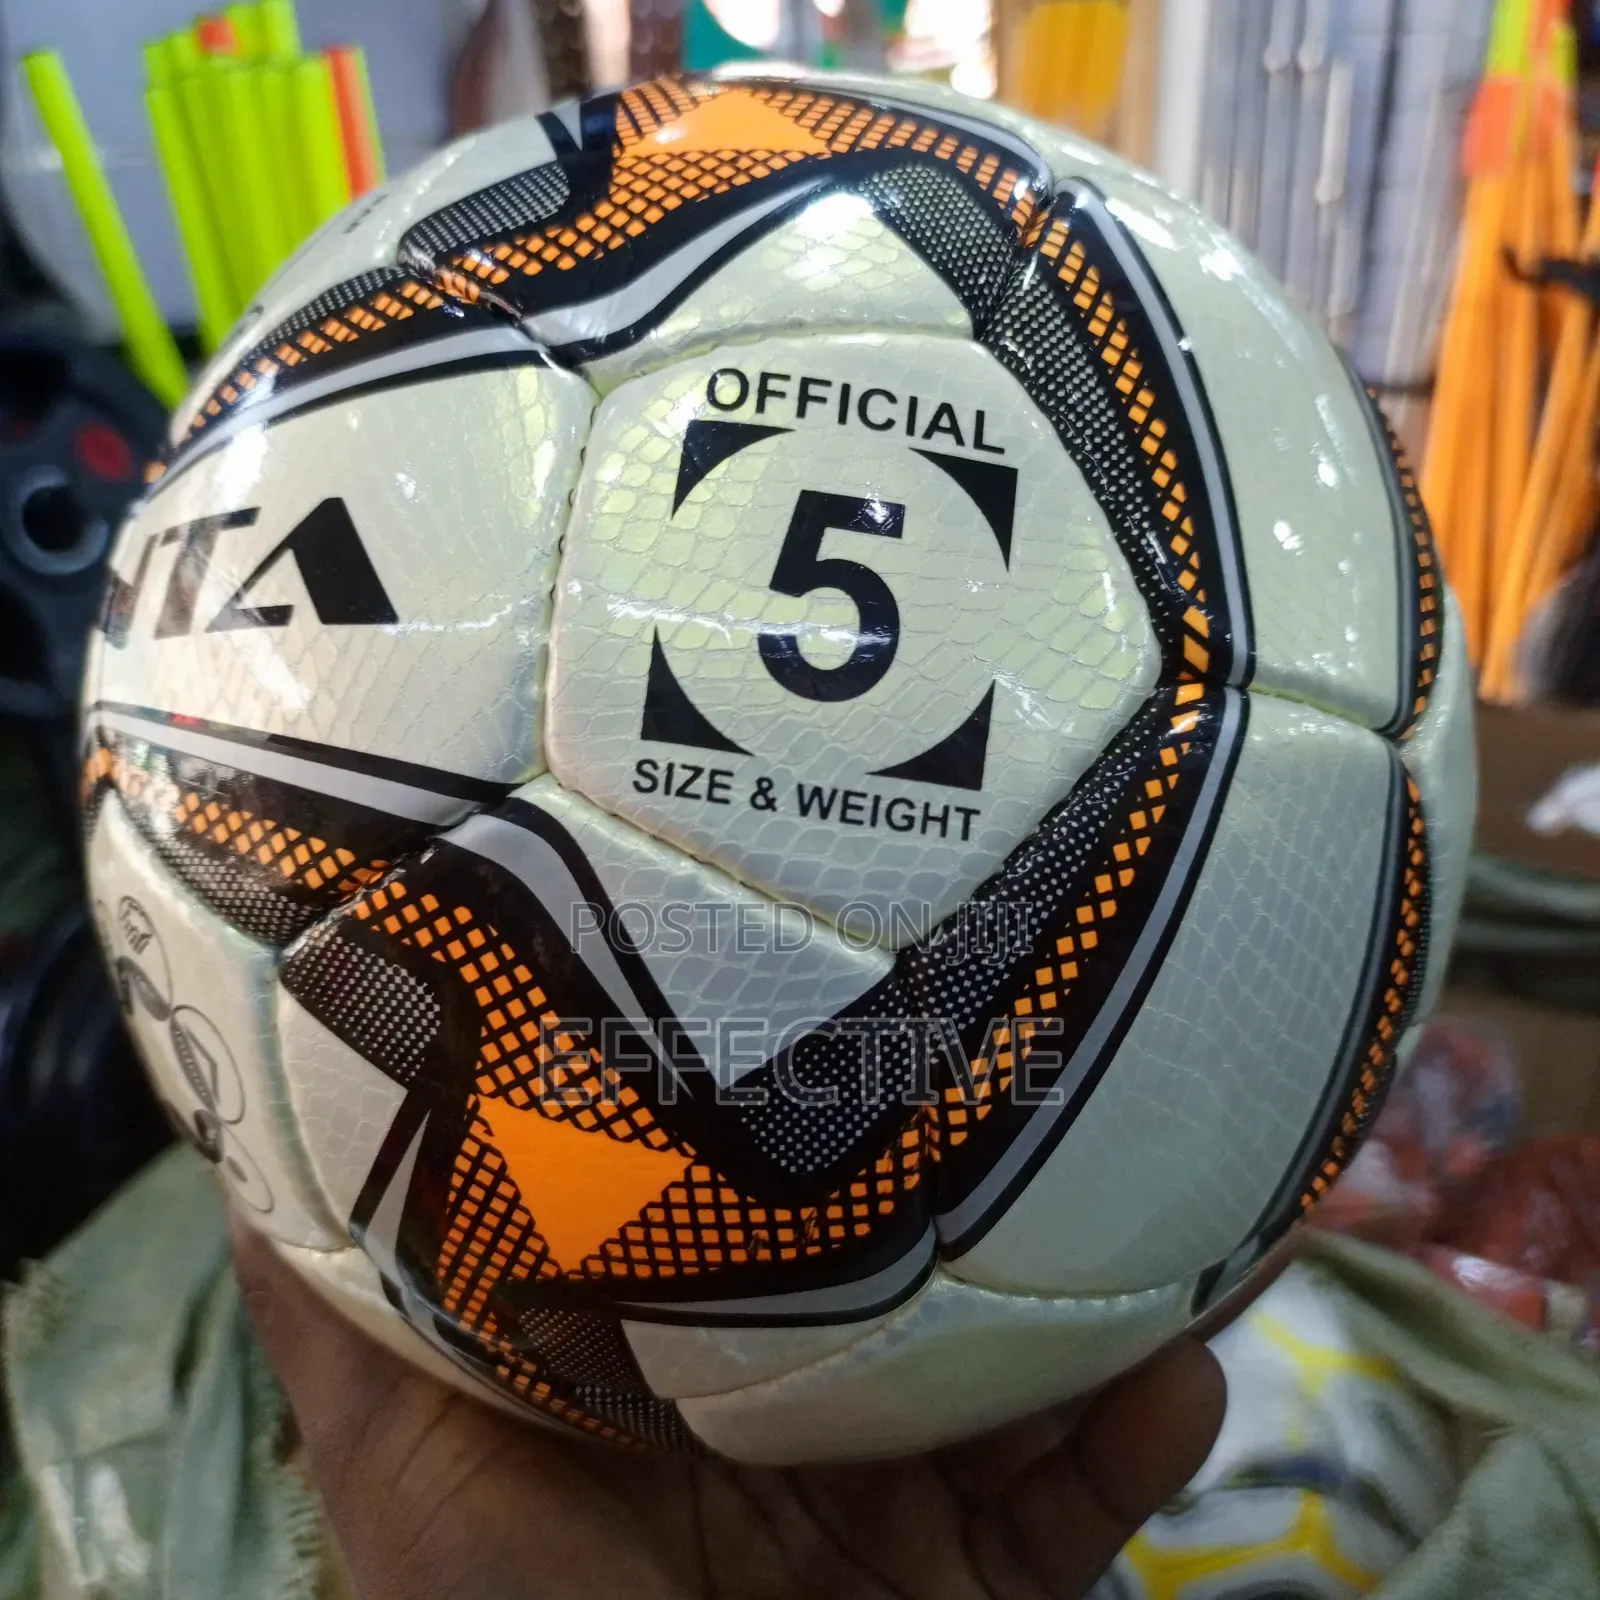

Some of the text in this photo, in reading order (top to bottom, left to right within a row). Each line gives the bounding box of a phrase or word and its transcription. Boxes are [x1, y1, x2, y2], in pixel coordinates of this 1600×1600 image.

[706, 367, 1006, 455] OFFICIAL
[757, 489, 905, 702] 5
[632, 759, 981, 842] SIZE & WEIGHT
